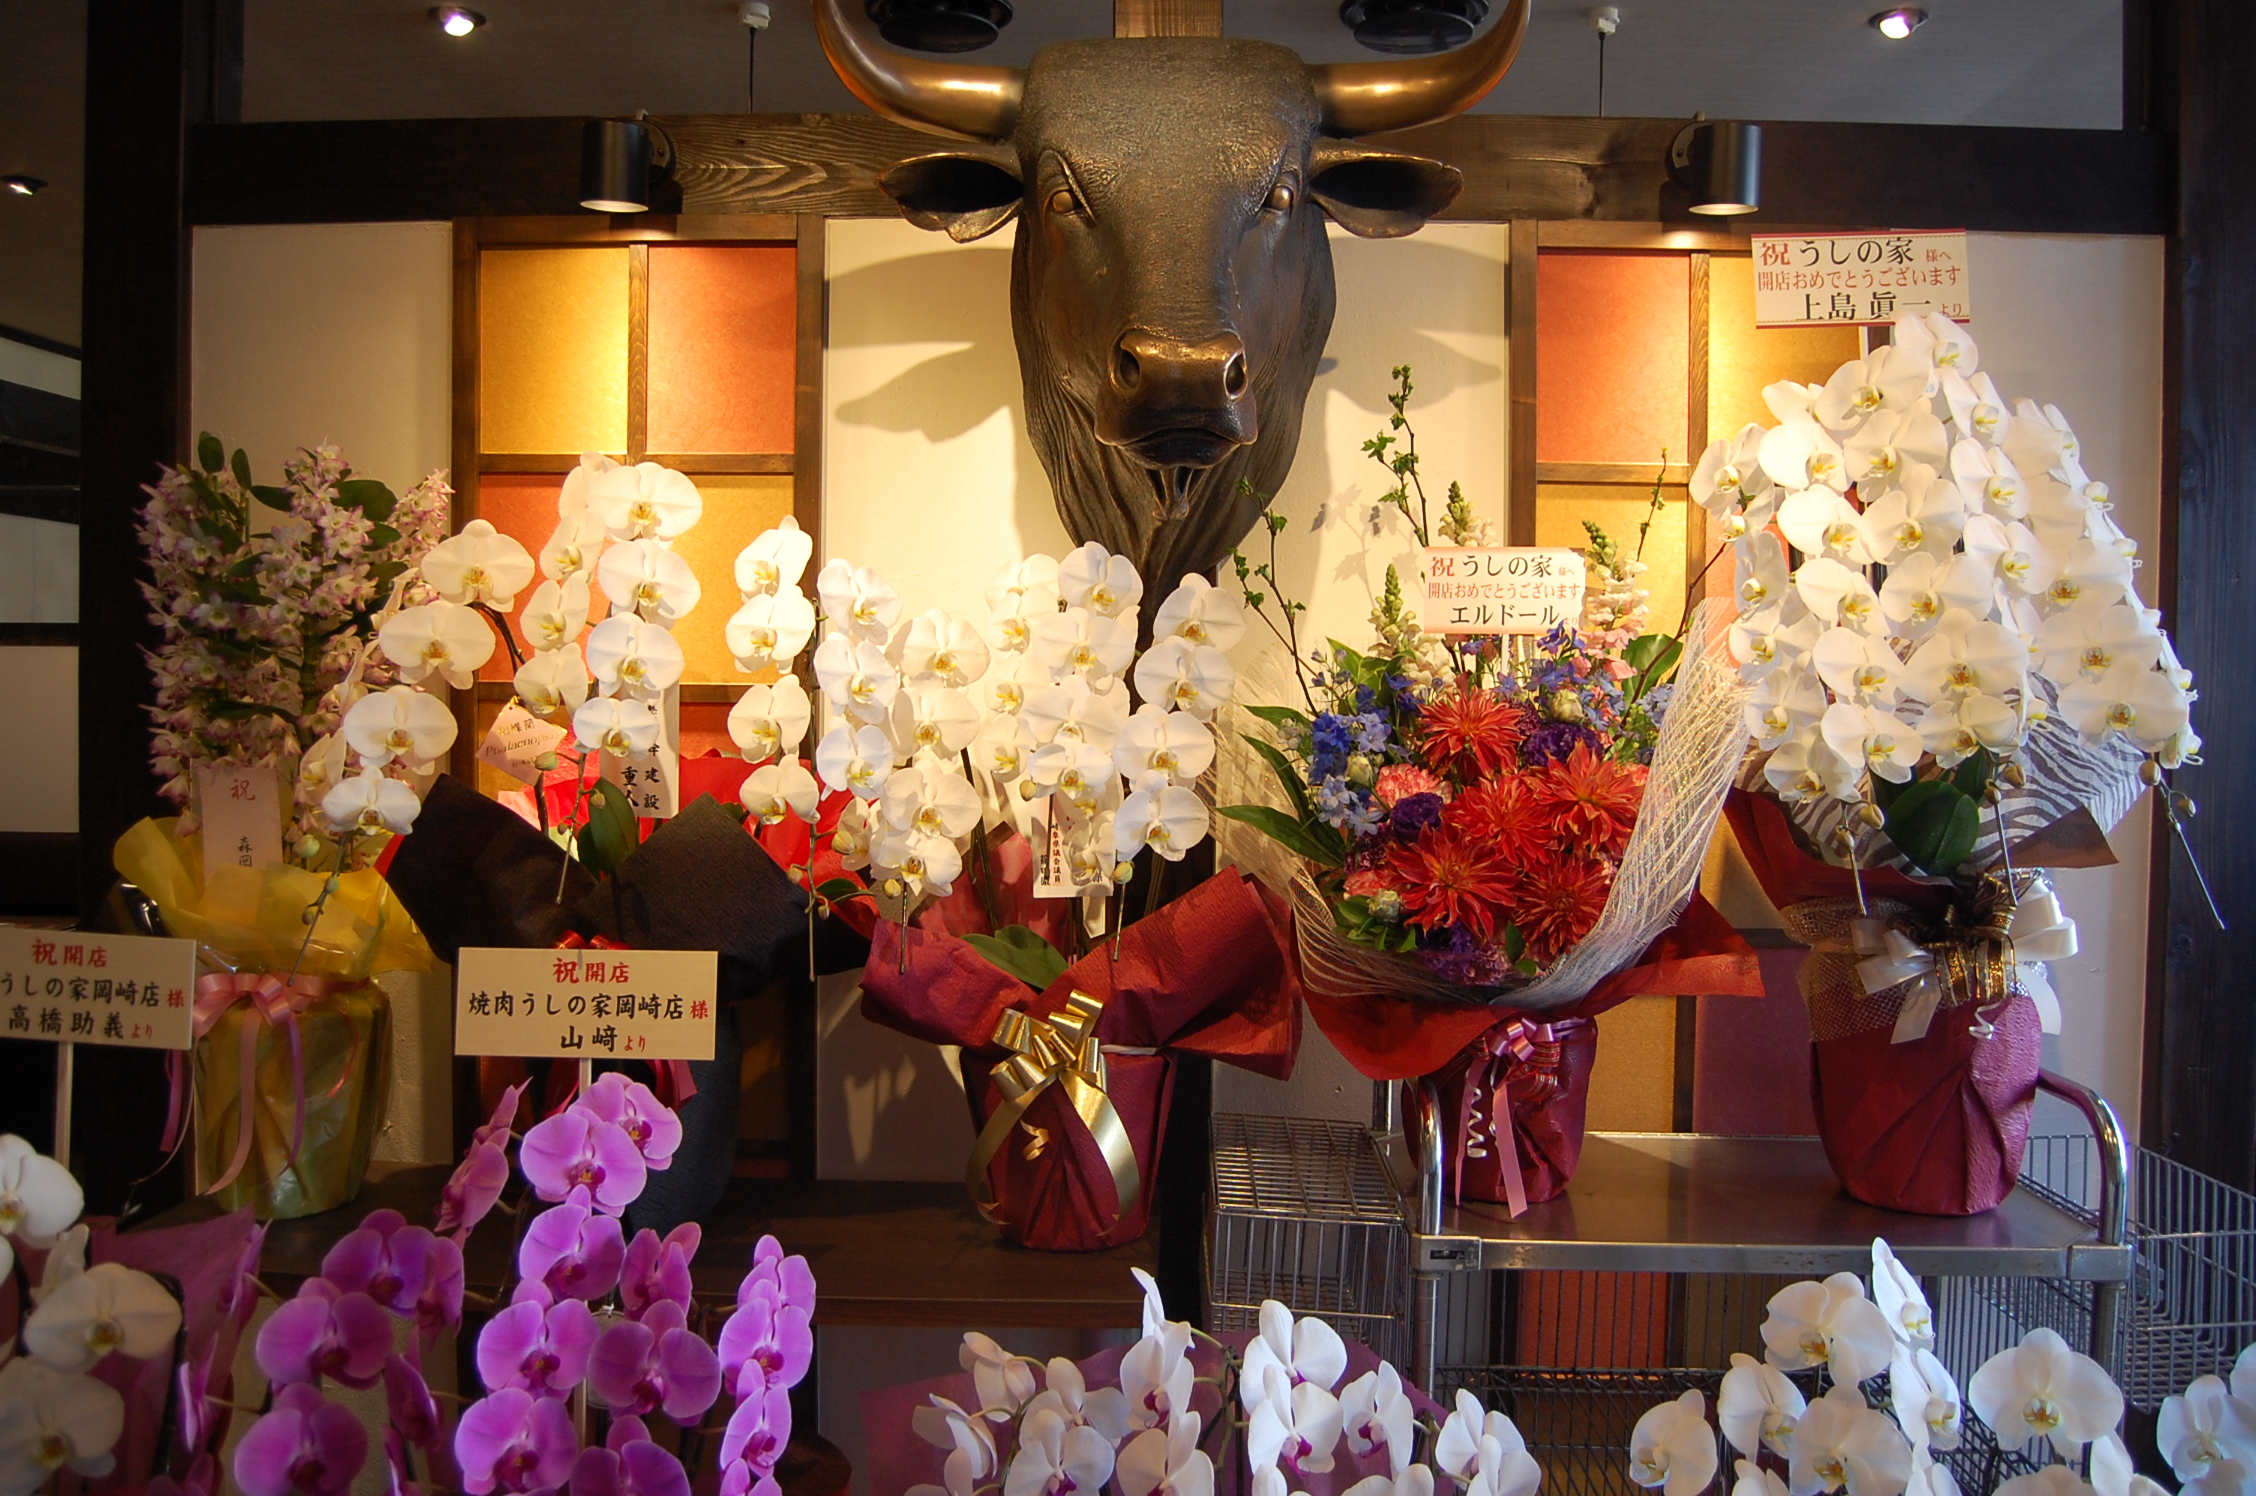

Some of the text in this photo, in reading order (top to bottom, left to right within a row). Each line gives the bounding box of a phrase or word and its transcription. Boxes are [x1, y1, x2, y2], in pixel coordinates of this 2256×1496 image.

[1757, 265, 1961, 291] 開店おめでとうございます
[1428, 582, 1580, 600] 開店おめでとうございます
[230, 778, 256, 801] 祝
[31, 938, 108, 968] 祝開店
[552, 957, 630, 984] 祝開店
